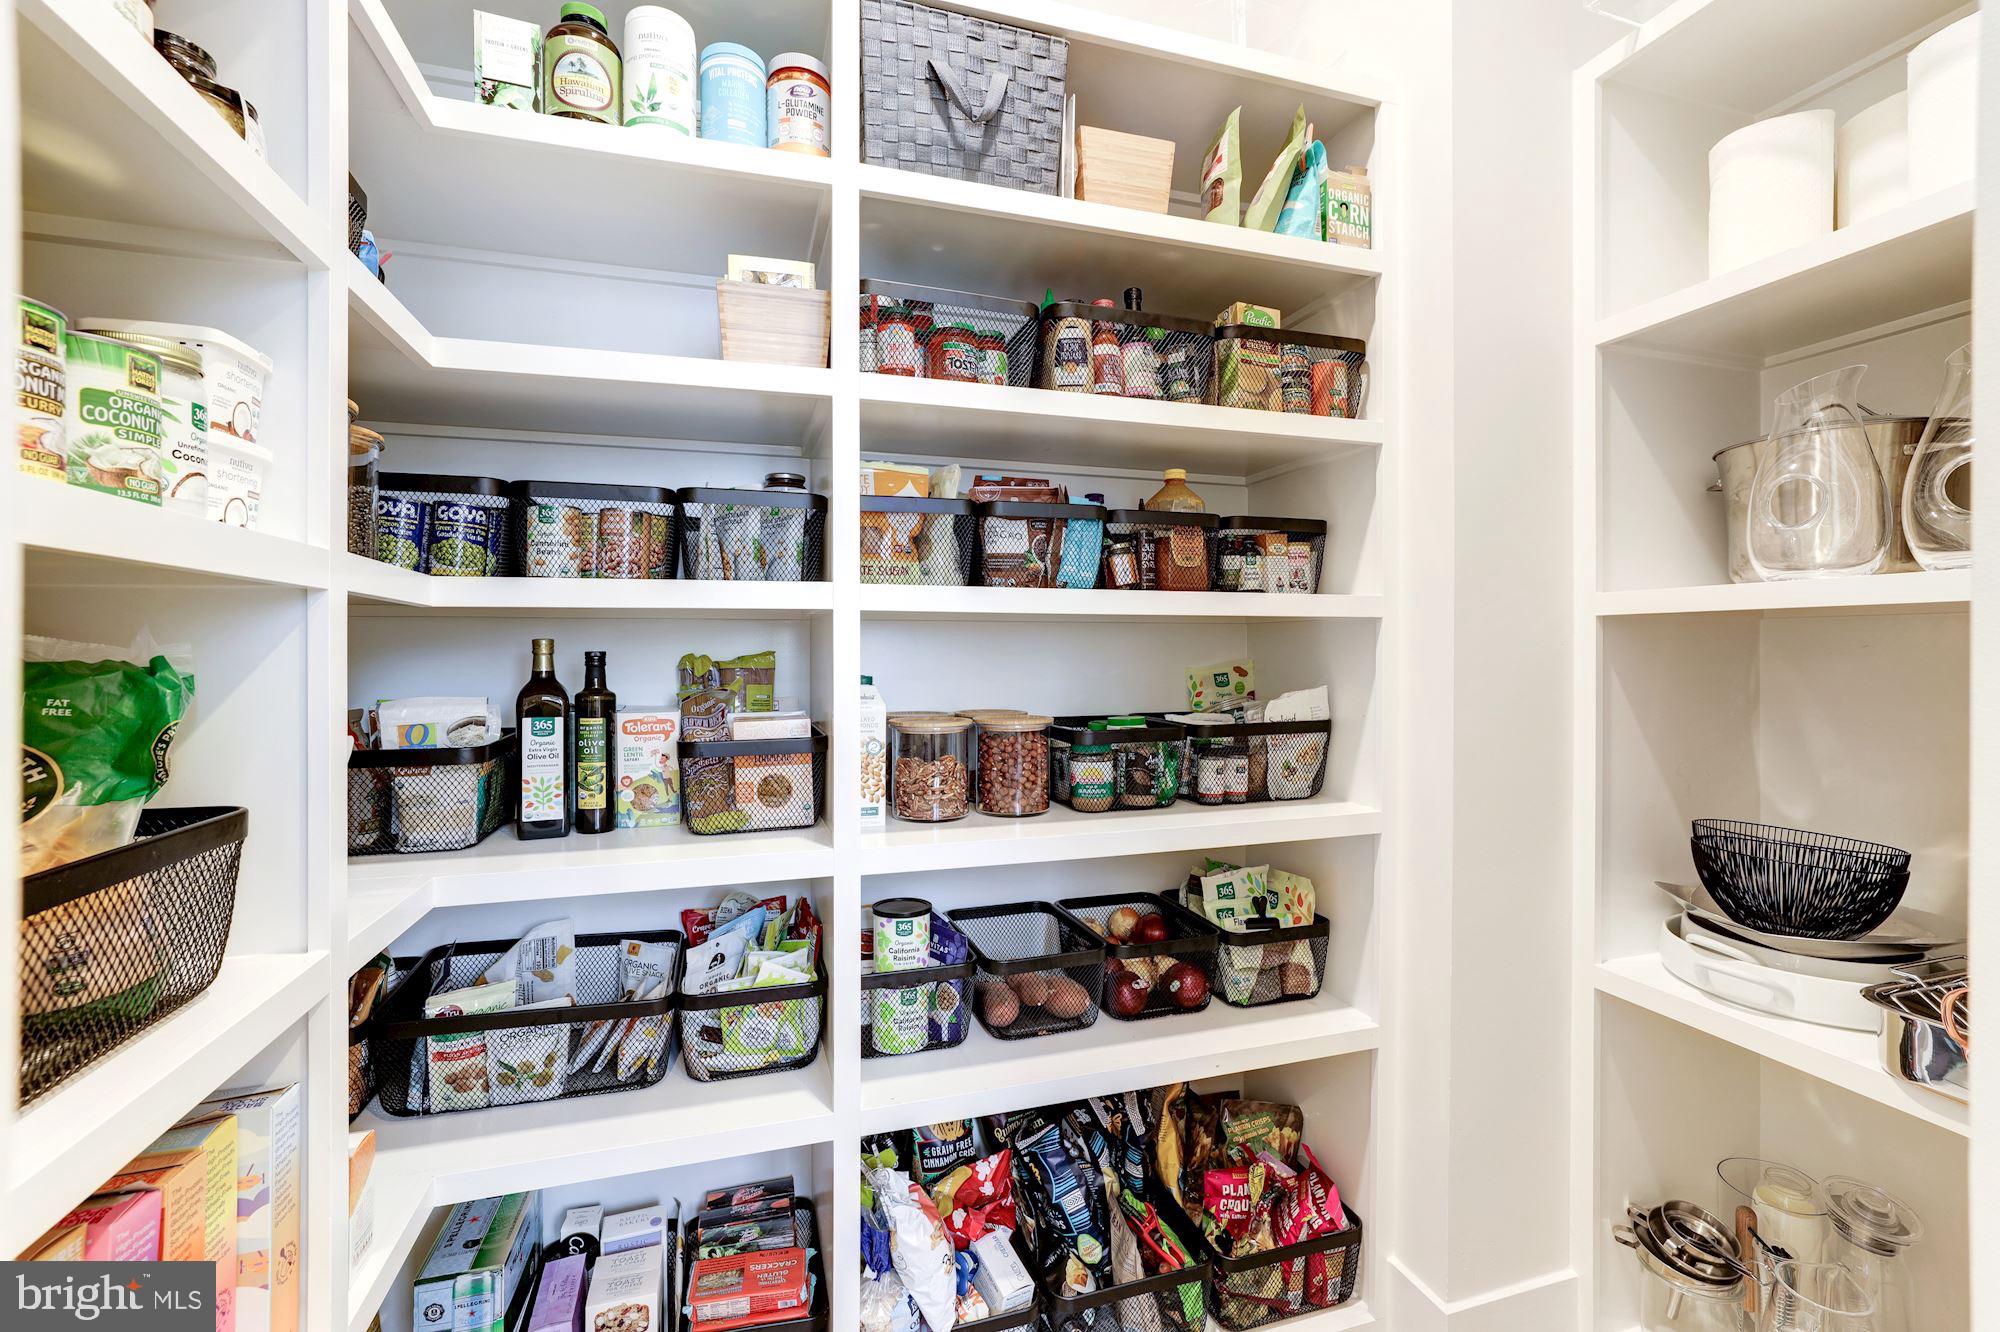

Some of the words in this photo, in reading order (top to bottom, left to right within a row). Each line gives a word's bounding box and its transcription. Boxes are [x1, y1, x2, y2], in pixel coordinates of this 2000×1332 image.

[708, 69, 725, 80] VITAL
[559, 77, 605, 95] Hawaiian
[559, 87, 605, 104] Spirulina
[778, 99, 824, 117] L-GLUTAMINE
[785, 108, 818, 121] POWDER
[1328, 188, 1369, 206] ORGANIC
[1328, 219, 1369, 240] STARCH
[1245, 310, 1272, 327] Pacific
[82, 405, 156, 433] COCONUT
[118, 429, 161, 449] SIMPLE
[229, 457, 254, 472] nutiva
[216, 469, 259, 489] shortening
[437, 504, 488, 525] GOYA
[46, 698, 71, 708] FAT
[41, 707, 72, 717] FREE
[533, 720, 553, 731] 365
[625, 721, 673, 731] Tolerant
[530, 739, 556, 747] Organic
[578, 739, 605, 747] olive
[548, 752, 560, 760] Oil
[1218, 884, 1233, 896] 365
[897, 923, 913, 931] 365
[888, 946, 921, 954] California
[624, 958, 659, 972] ORGANIC
[699, 972, 731, 990] ORGANIC
[1252, 1116, 1271, 1127] CRISPS
[931, 1143, 956, 1157] GRAIN
[956, 1137, 973, 1150] FREE
[749, 1259, 798, 1273] CRACKERS
[756, 1269, 789, 1279] GLUTEN
[607, 1276, 644, 1288] TOAST
